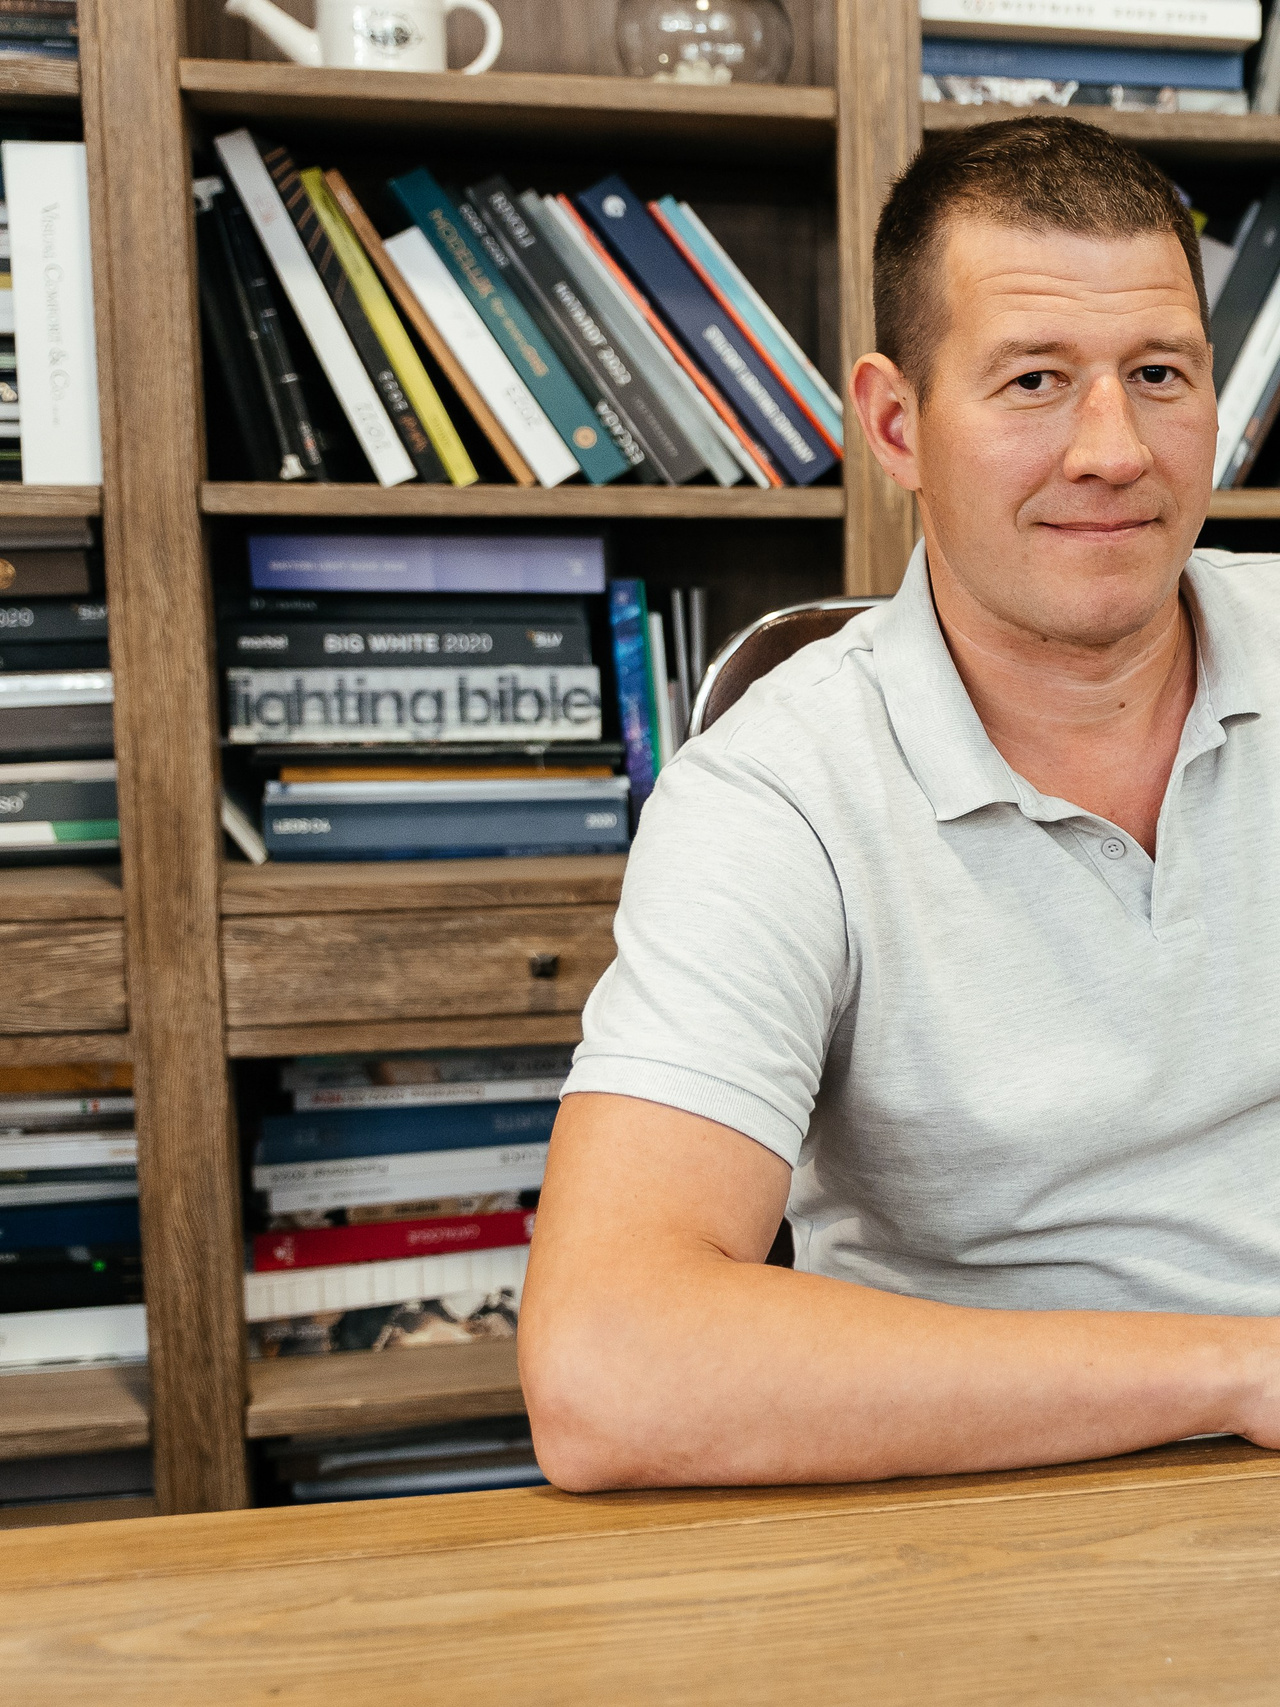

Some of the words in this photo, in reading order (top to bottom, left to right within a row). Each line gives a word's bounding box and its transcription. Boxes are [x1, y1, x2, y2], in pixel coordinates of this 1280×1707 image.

[47, 347, 68, 366] &
[594, 343, 634, 389] 2022
[590, 397, 648, 466] ESCADA
[734, 366, 782, 419] LIGHTING
[767, 409, 818, 467] COMPANY
[323, 633, 365, 653] BIG
[367, 633, 440, 652] WHITE
[441, 632, 493, 652] 2020
[533, 631, 563, 648] SLV
[458, 673, 598, 726] bible
